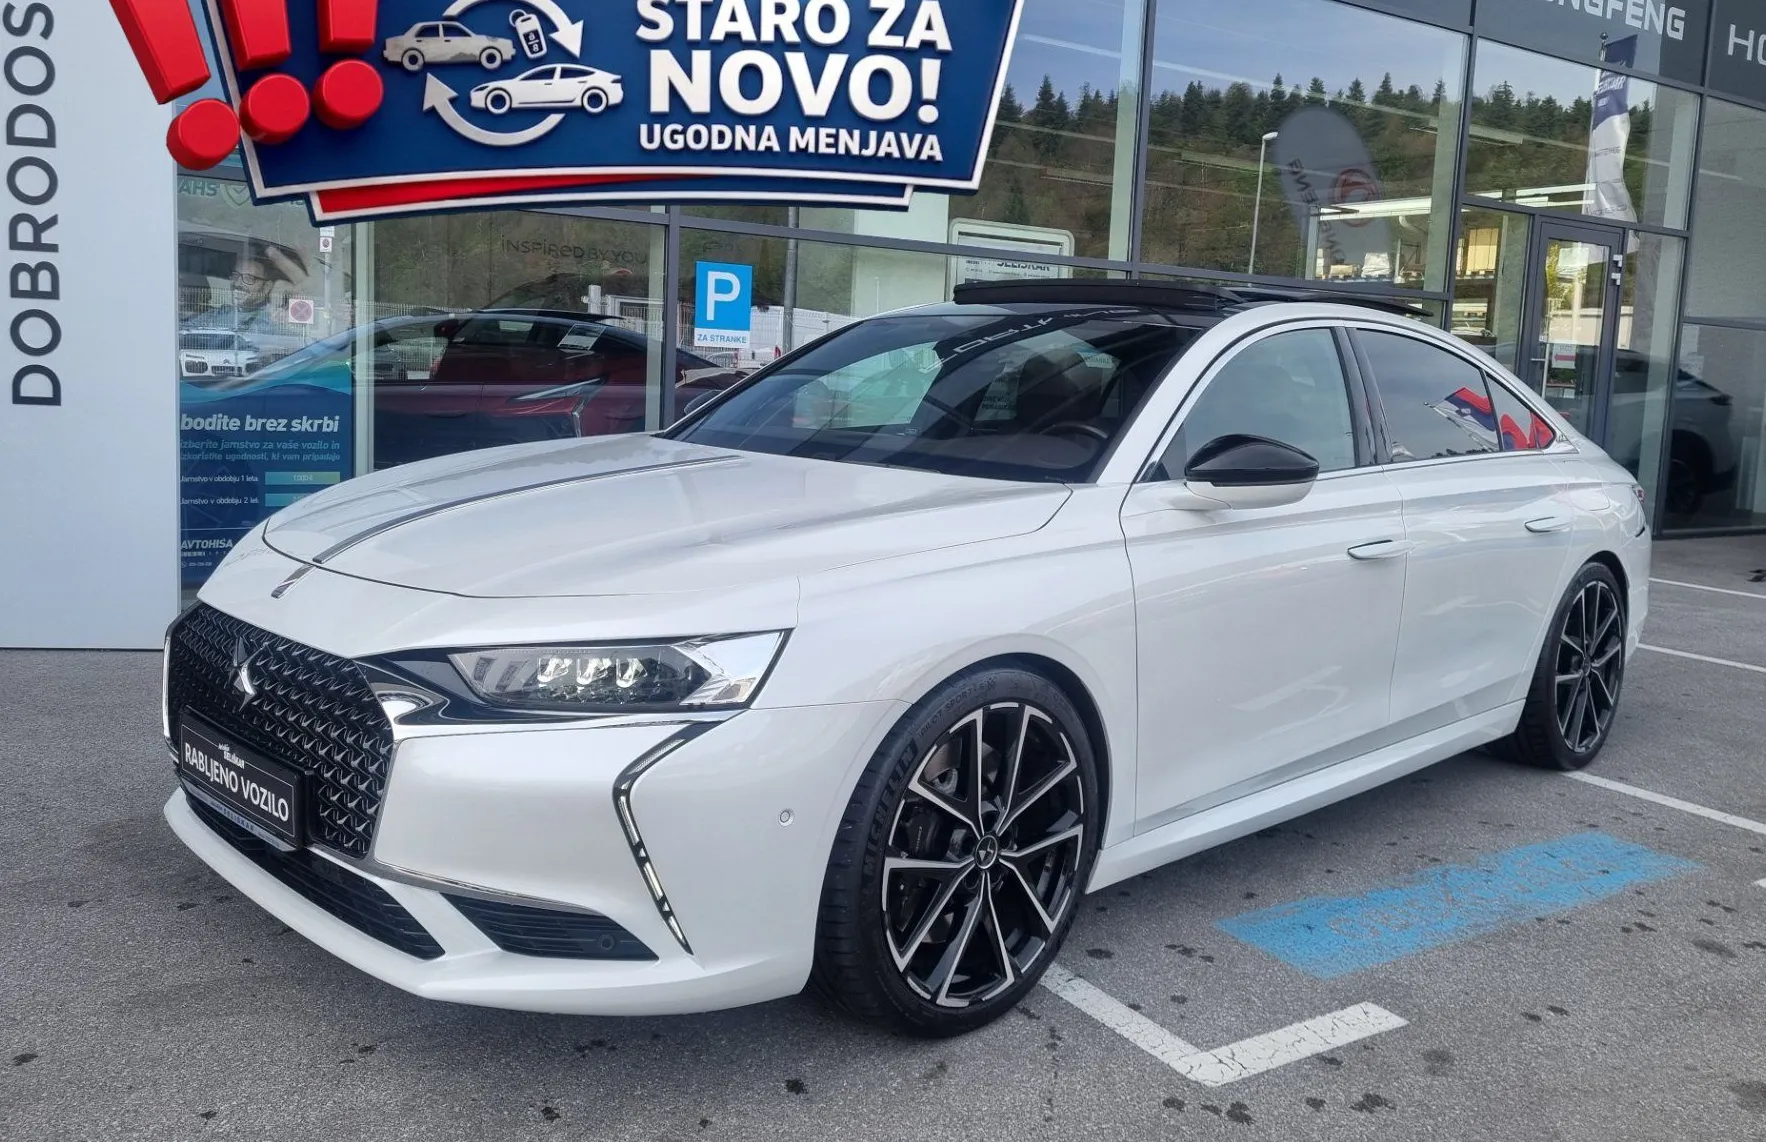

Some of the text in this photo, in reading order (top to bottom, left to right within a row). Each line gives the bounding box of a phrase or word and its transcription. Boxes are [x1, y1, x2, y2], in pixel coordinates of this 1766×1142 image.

[706, 270, 741, 321] P
[697, 333, 748, 344] ZA STRANKE
[180, 413, 340, 433] bodite brez skrbi
[220, 439, 260, 451] jamstvo
[262, 441, 274, 449] za
[276, 440, 299, 450] vaše
[301, 440, 329, 450] vozilo
[331, 440, 340, 450] in
[282, 453, 300, 461] vam
[216, 496, 242, 506] obdobju
[244, 496, 249, 504] 2
[184, 742, 289, 822] RABLJENO VOZILO
[862, 741, 918, 877] MICHELIN
